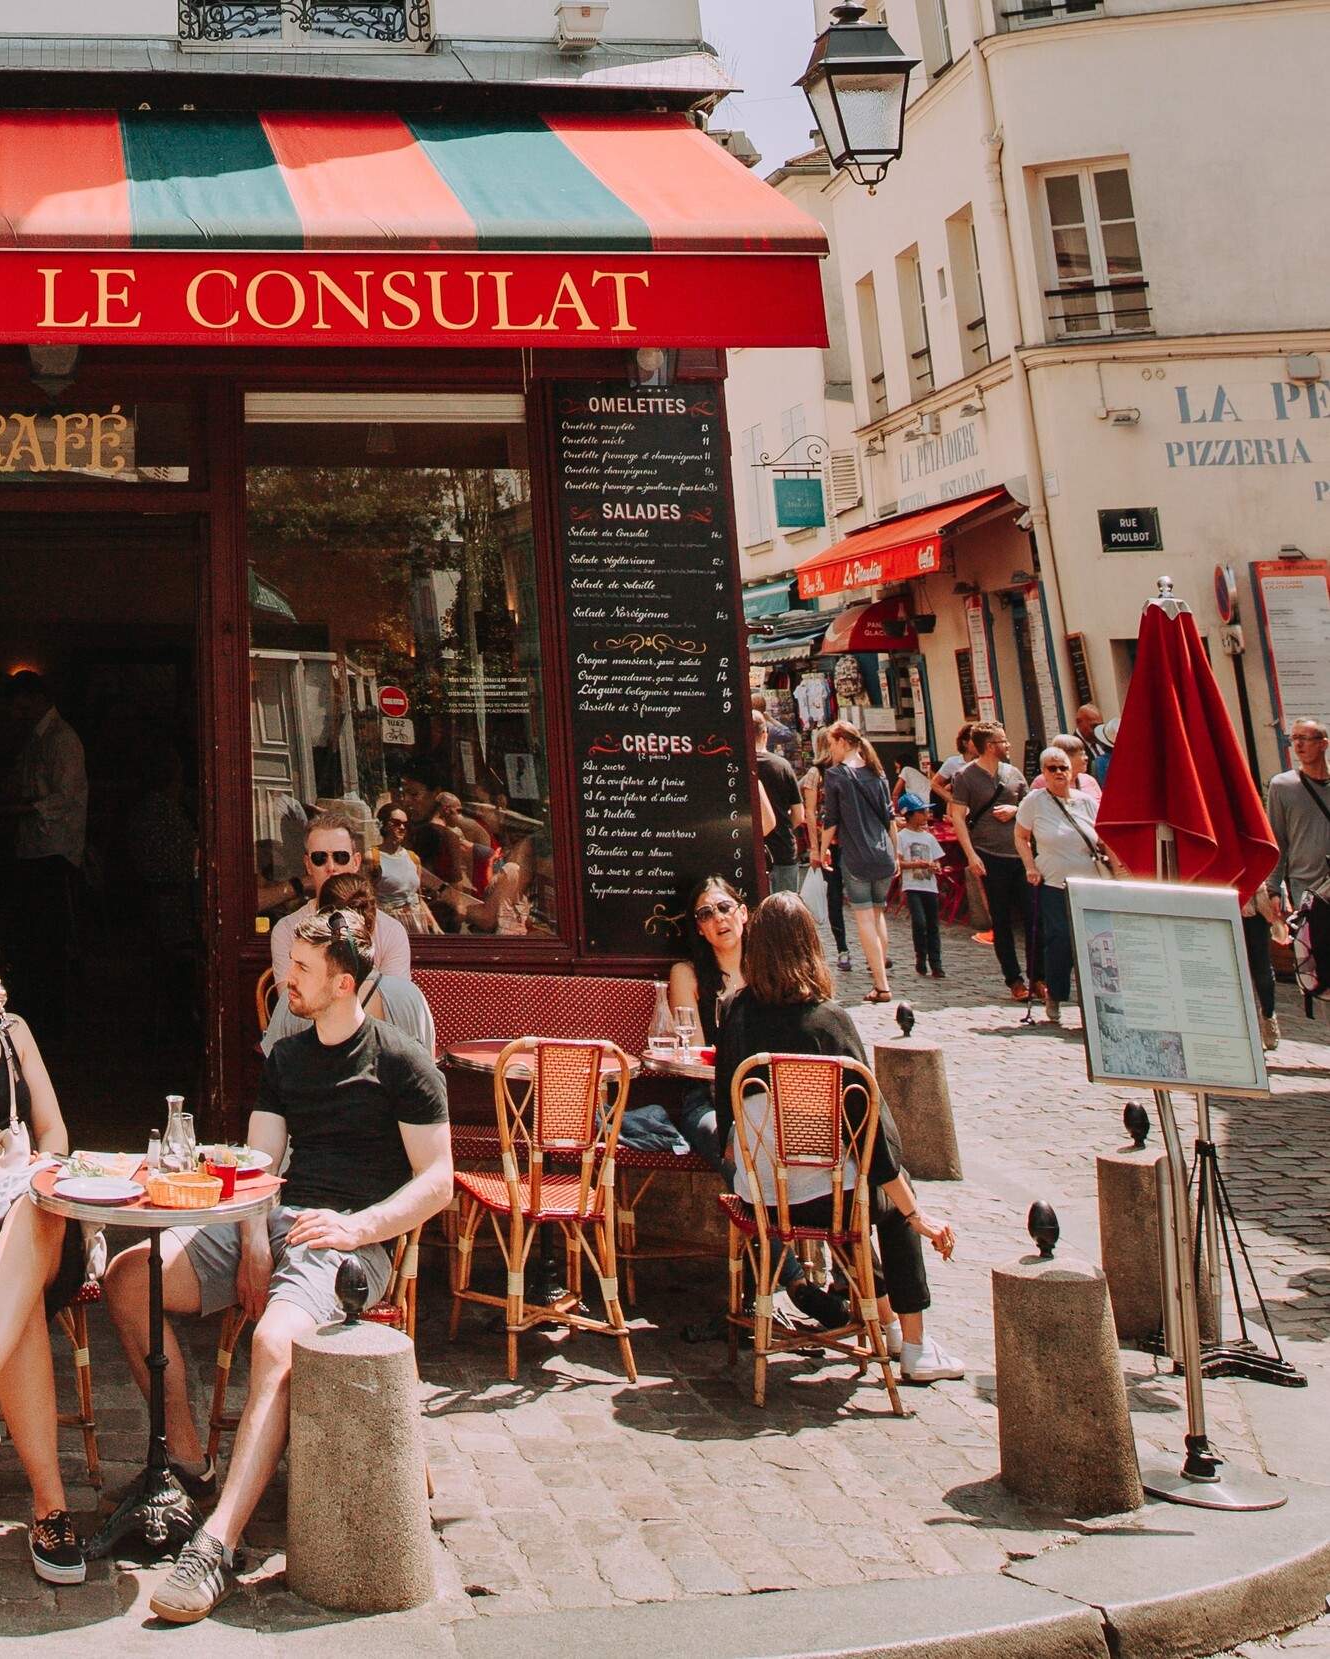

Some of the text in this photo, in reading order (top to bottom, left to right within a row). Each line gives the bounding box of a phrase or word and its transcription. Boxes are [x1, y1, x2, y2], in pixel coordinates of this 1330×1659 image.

[36, 268, 143, 329] LE
[185, 268, 649, 332] CONSULAT
[588, 397, 687, 414] OMELETTES
[1174, 385, 1243, 424] LA
[561, 420, 597, 430] Omelette
[562, 435, 598, 445] Omelette
[563, 450, 599, 460] Omelette
[602, 451, 639, 464] fromage
[651, 451, 703, 465] champignons
[1165, 437, 1313, 468] PIZZERIA
[602, 502, 681, 520] SALADES
[1120, 518, 1138, 527] RUE
[1111, 532, 1150, 542] POULBOT
[571, 578, 604, 589] Salade
[607, 580, 620, 589] de
[622, 580, 656, 590] volaille
[577, 684, 623, 700] Linguine
[624, 686, 670, 700] bolognaise
[673, 689, 707, 697] maison
[579, 700, 732, 718] Assiette de 3 fromages 9
[622, 732, 693, 753] CRÊPES
[594, 775, 606, 786] la
[607, 775, 645, 791] confiture
[648, 776, 659, 786] de
[661, 778, 686, 791] fraise
[728, 777, 736, 787] 6
[594, 791, 607, 801] la
[610, 792, 647, 807] confiture
[729, 793, 737, 804] 6
[585, 807, 738, 821] Au Nutella 6
[598, 826, 608, 837] la
[611, 828, 638, 837] crème
[641, 828, 652, 837] de
[656, 831, 696, 839] marrons
[731, 829, 739, 839] 6
[586, 843, 741, 859] Flambées au rhum 8
